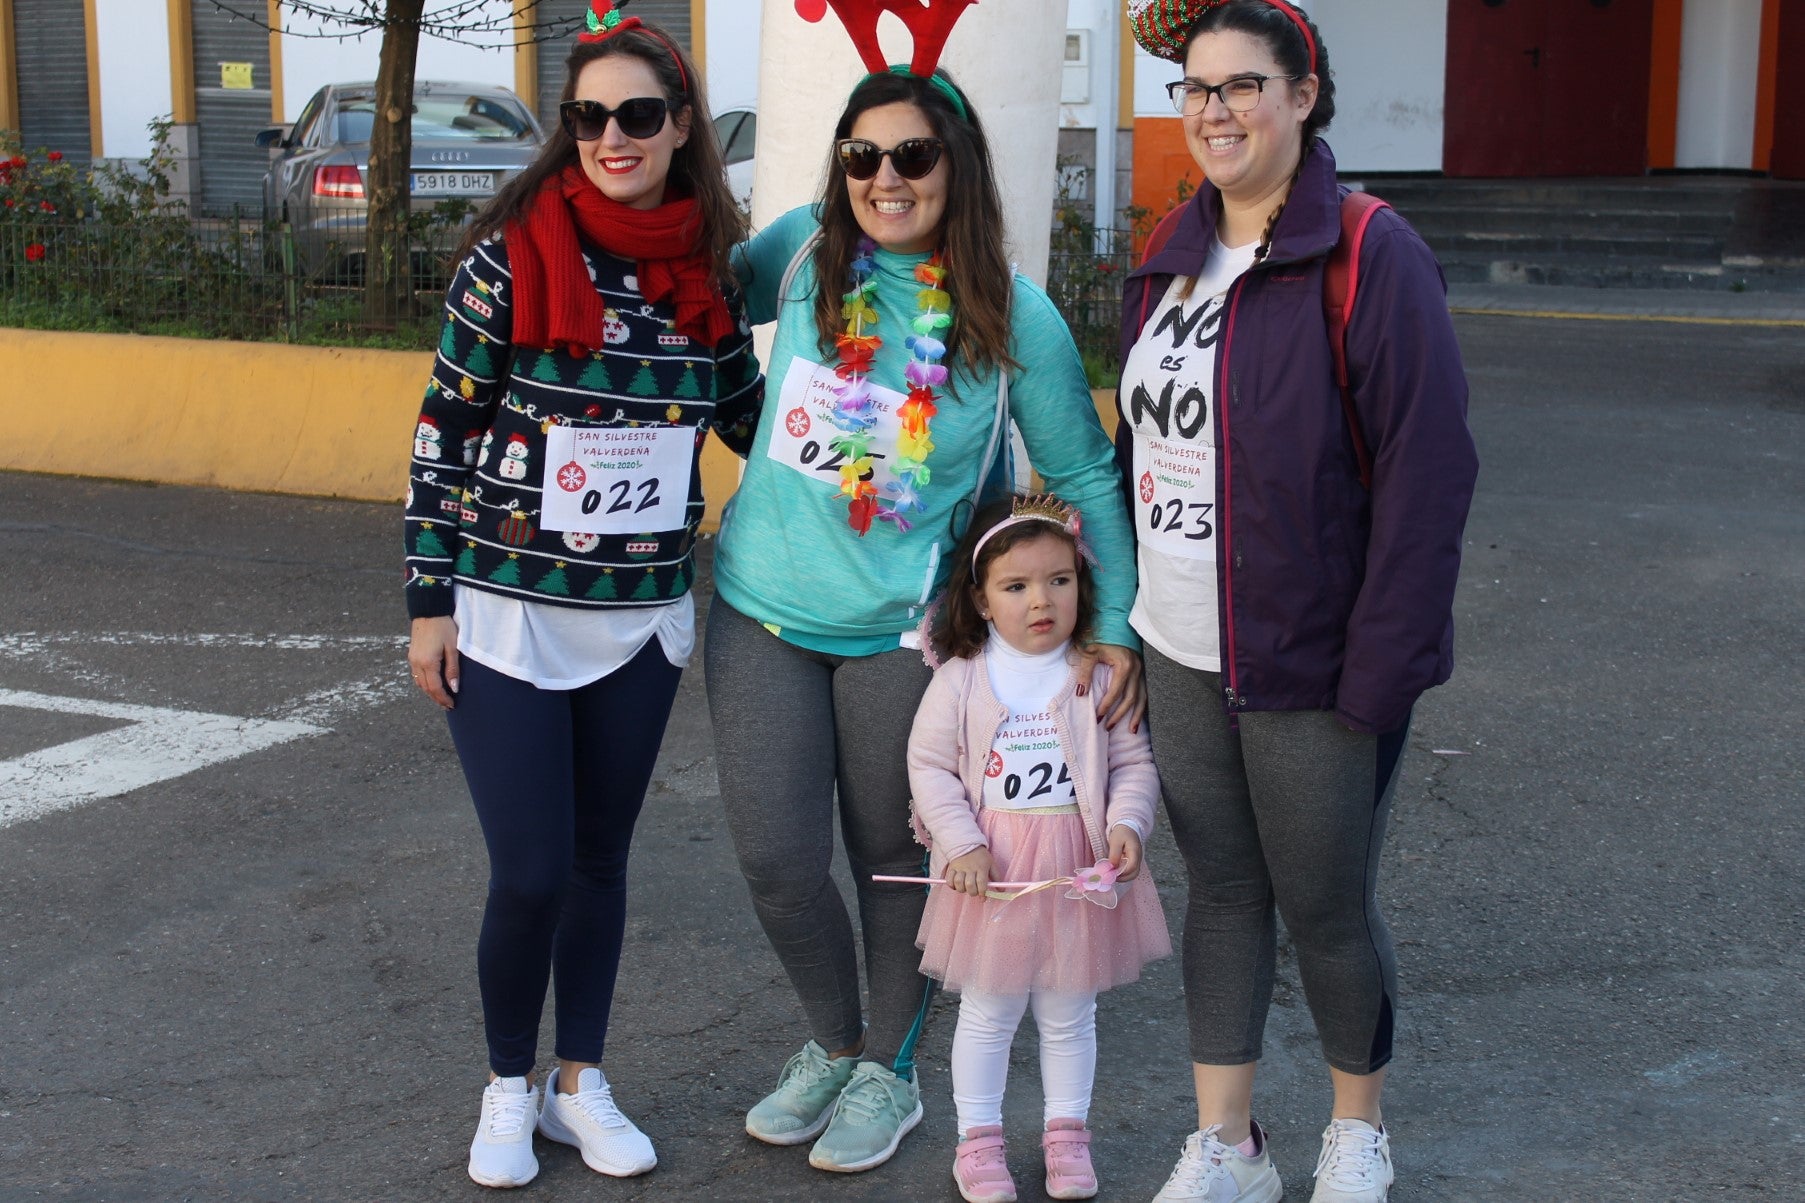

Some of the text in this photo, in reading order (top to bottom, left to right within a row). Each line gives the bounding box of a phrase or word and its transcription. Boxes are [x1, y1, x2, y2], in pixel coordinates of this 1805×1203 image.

[417, 174, 490, 189] 5918 DHZ
[1150, 297, 1223, 350] NO
[1159, 354, 1188, 372] es
[812, 380, 834, 393] SAN
[1131, 376, 1208, 439] NO
[578, 432, 658, 442] SAN SILVESTRE
[584, 447, 650, 456] VALVERDEÑA
[1150, 441, 1208, 461] SAN SILVESTRE
[1154, 459, 1201, 475] VALVERDEÑA
[1173, 478, 1188, 488] 2020
[581, 477, 661, 515] 022
[1150, 498, 1214, 540] 023
[1014, 712, 1051, 723] SILVES
[1014, 741, 1052, 752] Feliz 2020
